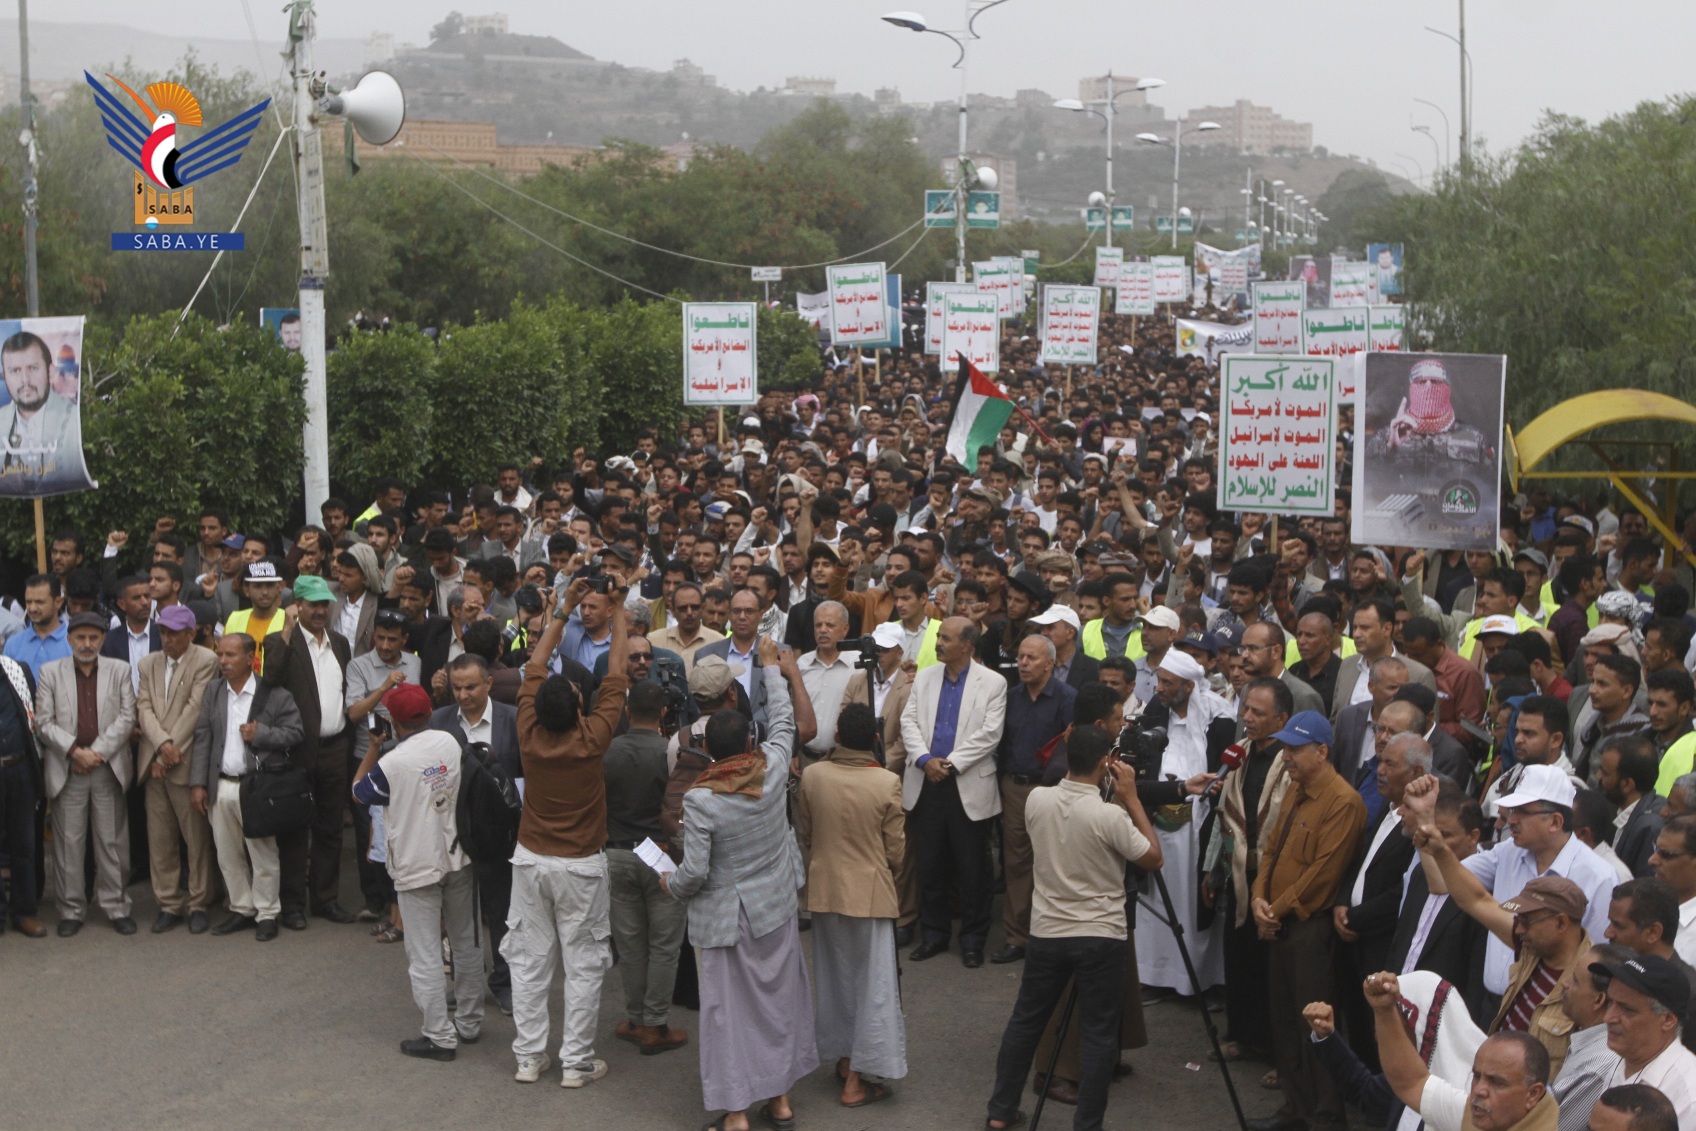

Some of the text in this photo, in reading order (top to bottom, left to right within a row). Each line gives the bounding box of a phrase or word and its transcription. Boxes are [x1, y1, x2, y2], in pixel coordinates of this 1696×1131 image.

[834, 270, 880, 288] قاطعوا
[948, 299, 994, 315] قاطعوا
[690, 312, 749, 333] قاطعوا
[1306, 314, 1365, 337] قاطعوا
[691, 336, 750, 354] البضائع الأمريكية
[717, 358, 722, 371] و
[1231, 361, 1290, 398] أكبر
[1292, 366, 1328, 391] الله
[1231, 397, 1327, 421] الموت لأمريكا
[1230, 425, 1326, 447] الموت لإسرائيل
[1228, 451, 1325, 471] اللعنة على اليهود
[1228, 474, 1324, 504] النصر للإسلام
